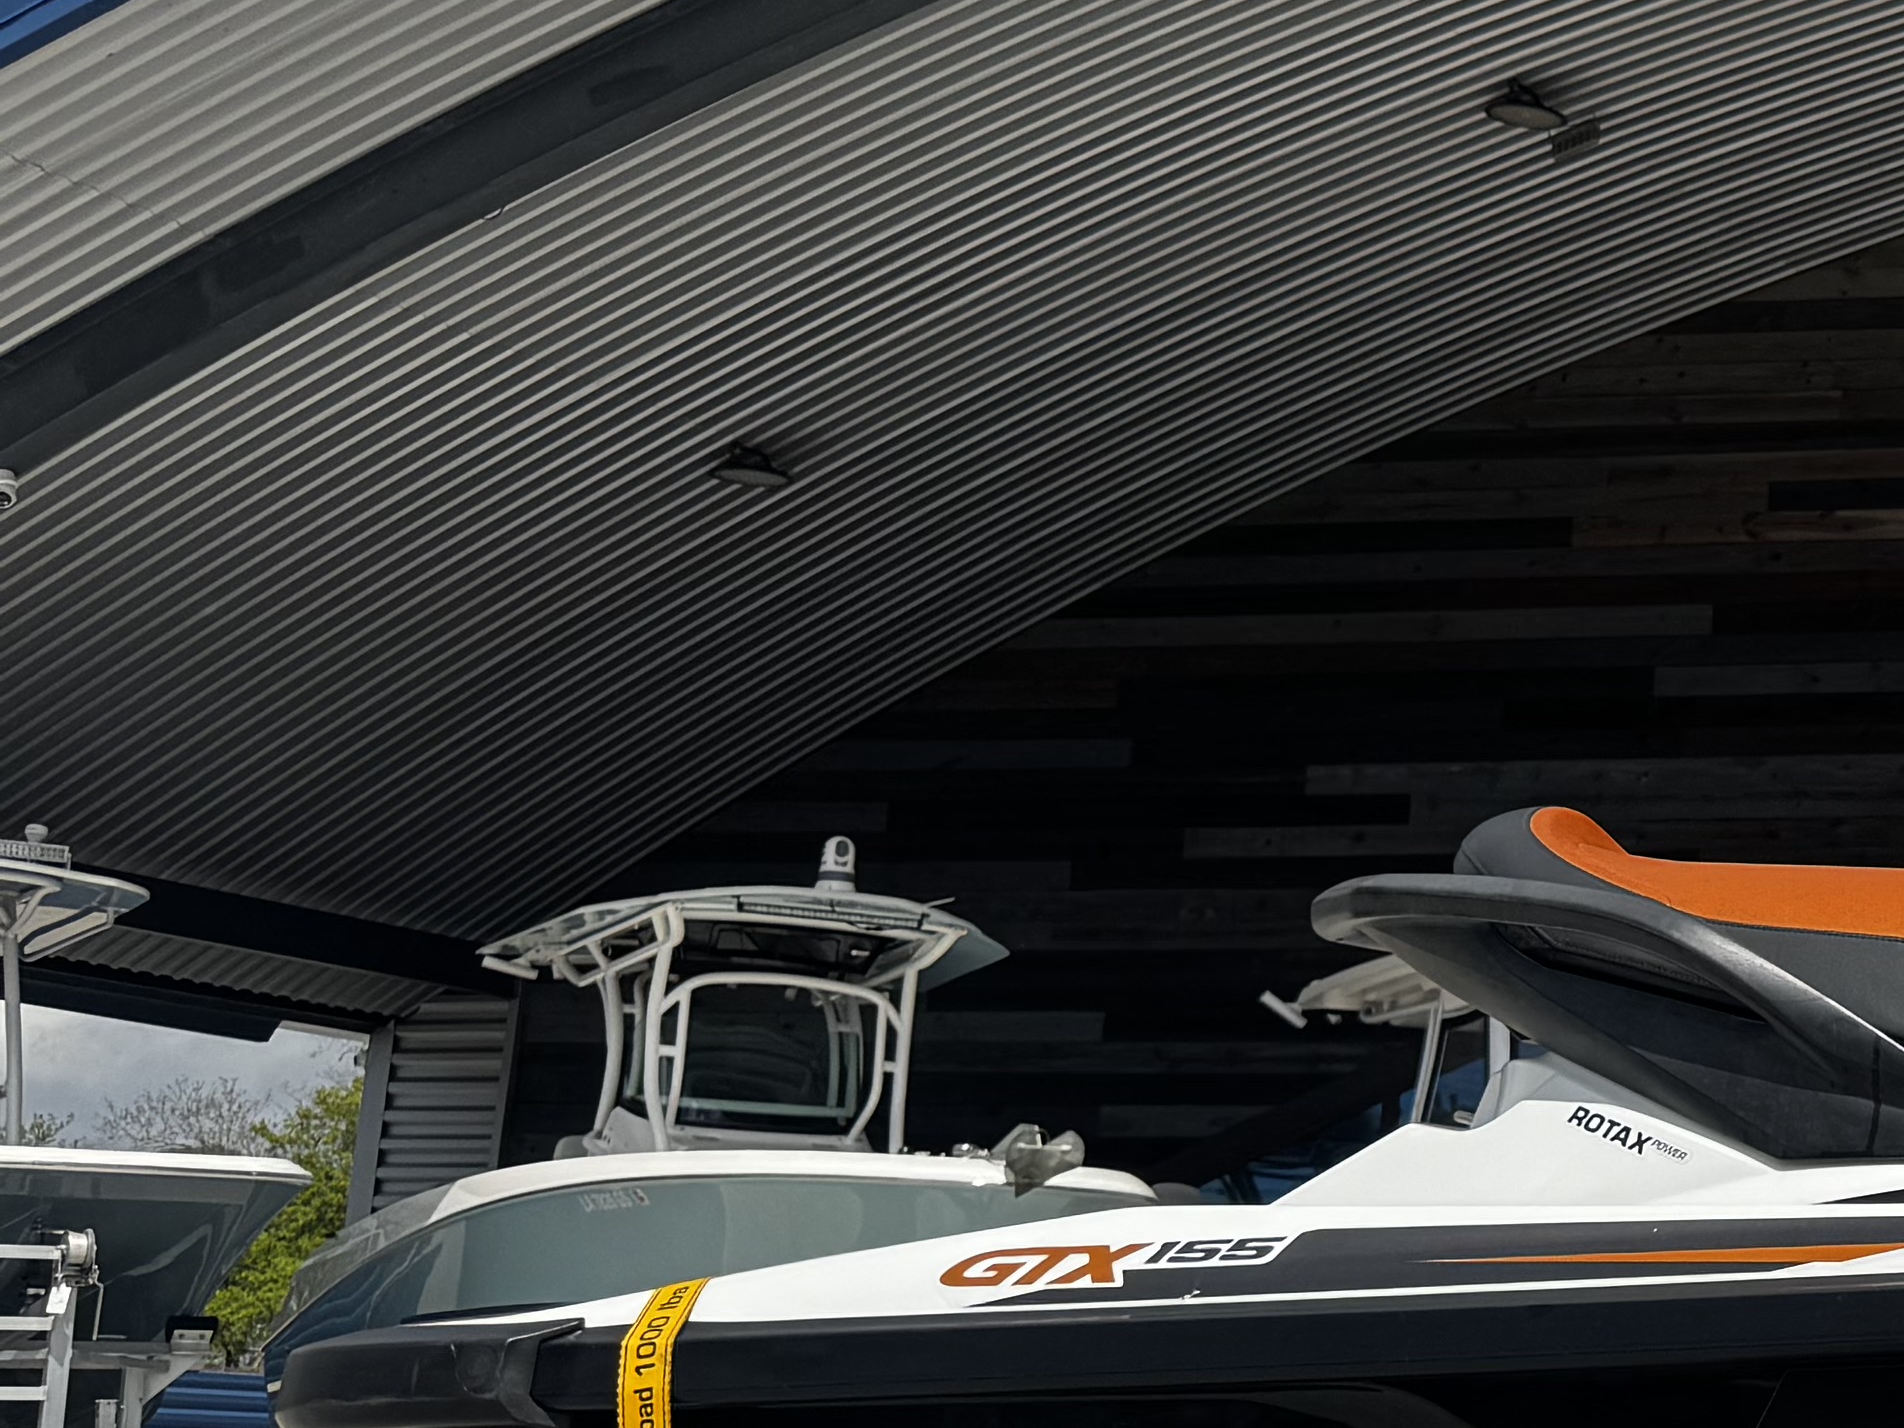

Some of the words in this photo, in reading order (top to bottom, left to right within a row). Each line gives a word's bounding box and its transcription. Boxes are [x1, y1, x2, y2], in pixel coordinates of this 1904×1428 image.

[1566, 1105, 1654, 1156] ROTAX
[1651, 1138, 1689, 1161] POWER
[939, 1242, 1154, 1287] GTX
[1144, 1236, 1288, 1265] 155
[634, 1315, 670, 1376] 1000
